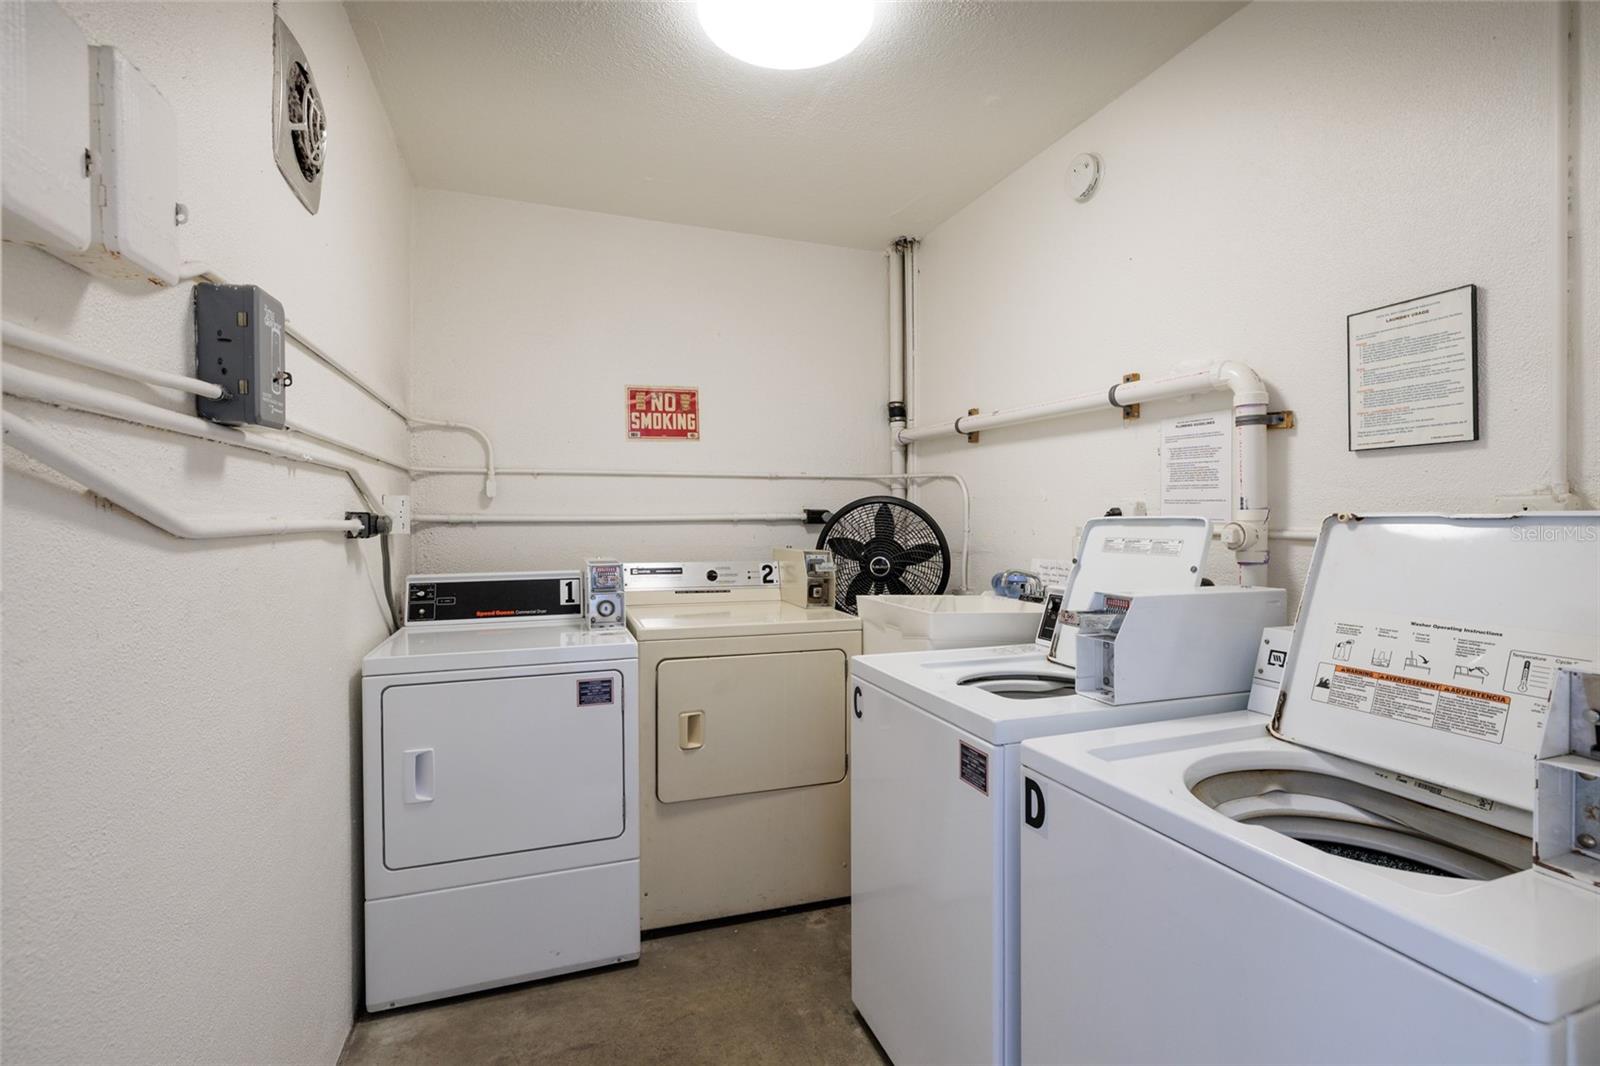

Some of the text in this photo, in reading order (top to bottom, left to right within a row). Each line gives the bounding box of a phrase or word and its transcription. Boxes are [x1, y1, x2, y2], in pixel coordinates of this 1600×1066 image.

[651, 392, 676, 412] NO
[631, 412, 696, 430] SMOKING
[761, 564, 775, 584] 2
[565, 581, 575, 603] 1
[1410, 621, 1503, 638] Washer Operating Instructions
[1512, 652, 1547, 662] Temperature
[1345, 667, 1374, 677] WARNING
[1383, 674, 1440, 690] AVERTISSEMENT
[853, 686, 863, 719] C
[1451, 686, 1507, 703] ADVERTENCIA
[1025, 776, 1046, 829] D
